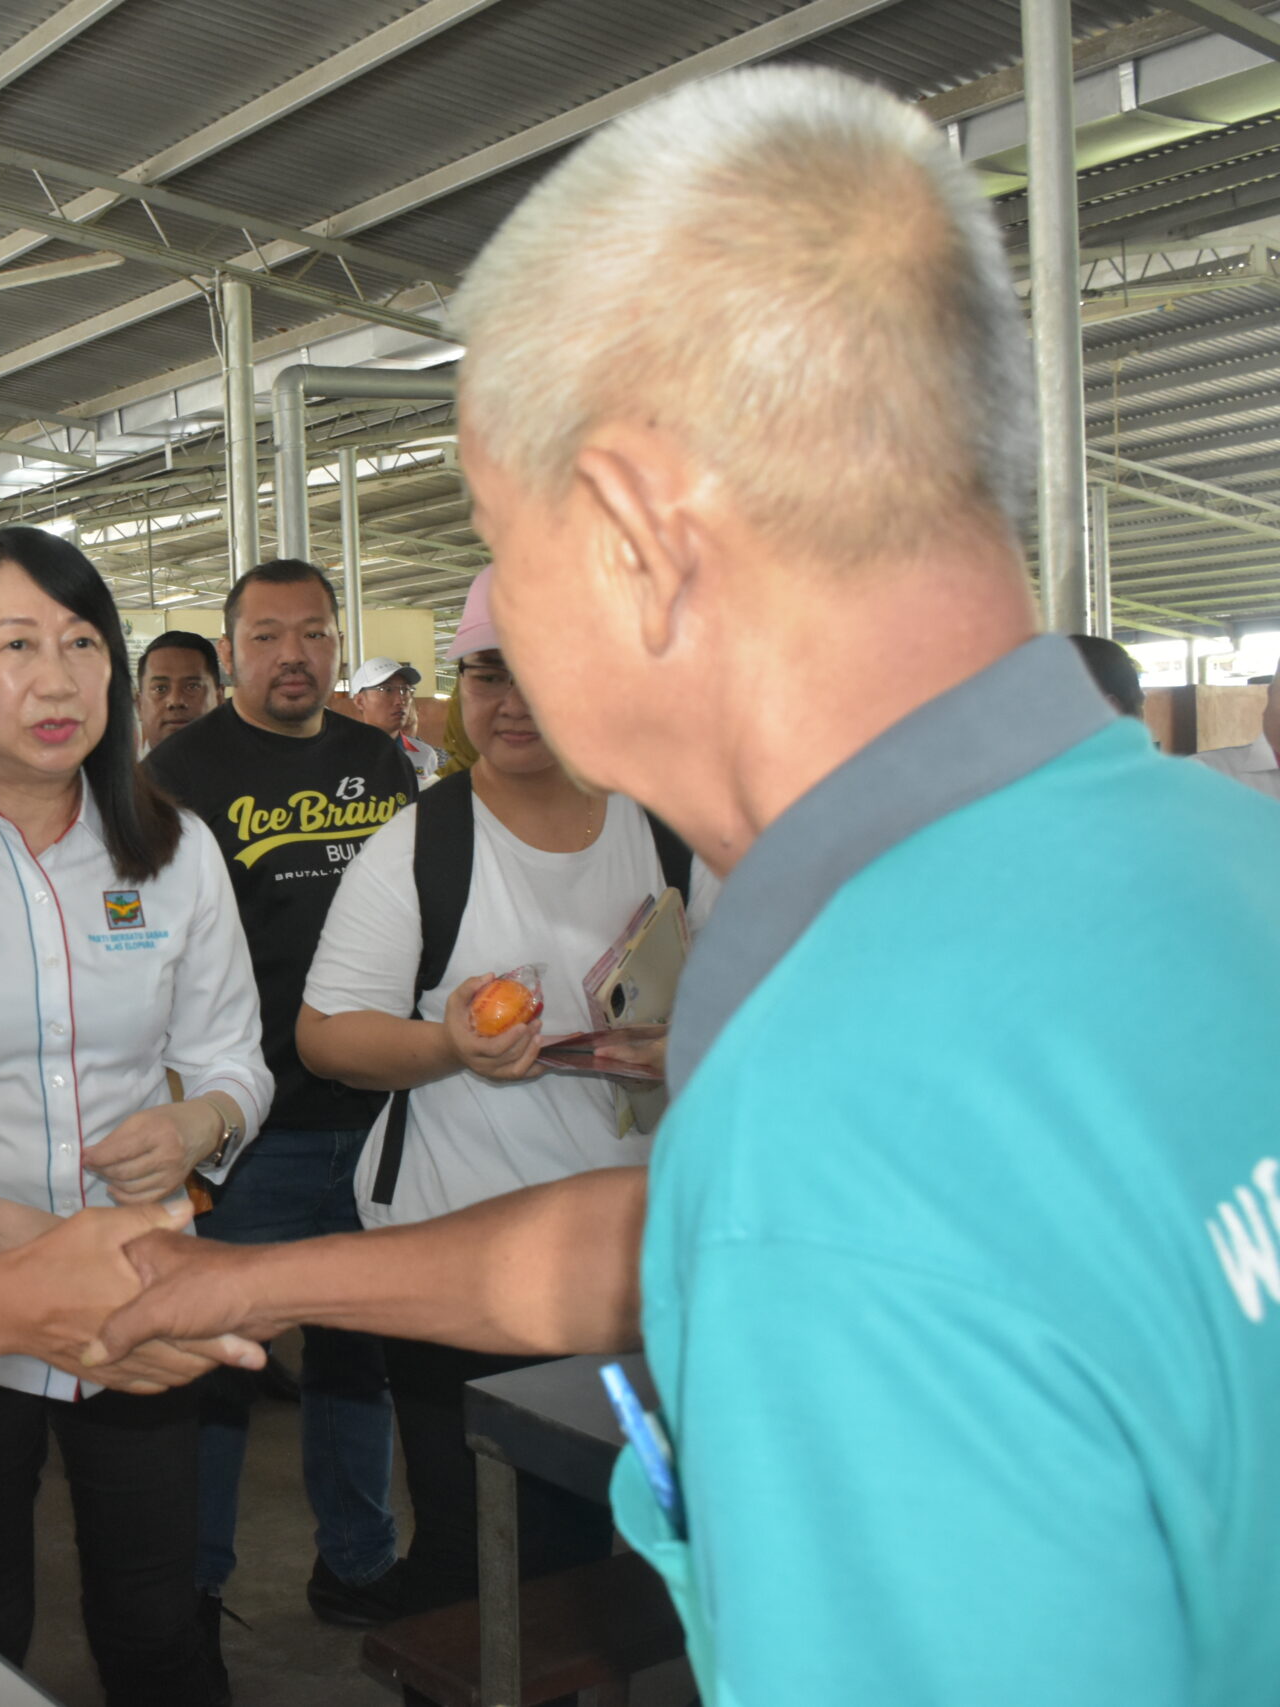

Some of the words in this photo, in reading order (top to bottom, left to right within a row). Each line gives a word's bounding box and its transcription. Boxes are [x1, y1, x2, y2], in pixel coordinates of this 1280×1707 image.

[336, 776, 365, 800] 13
[228, 795, 293, 841] Ice
[326, 842, 366, 862] BUL
